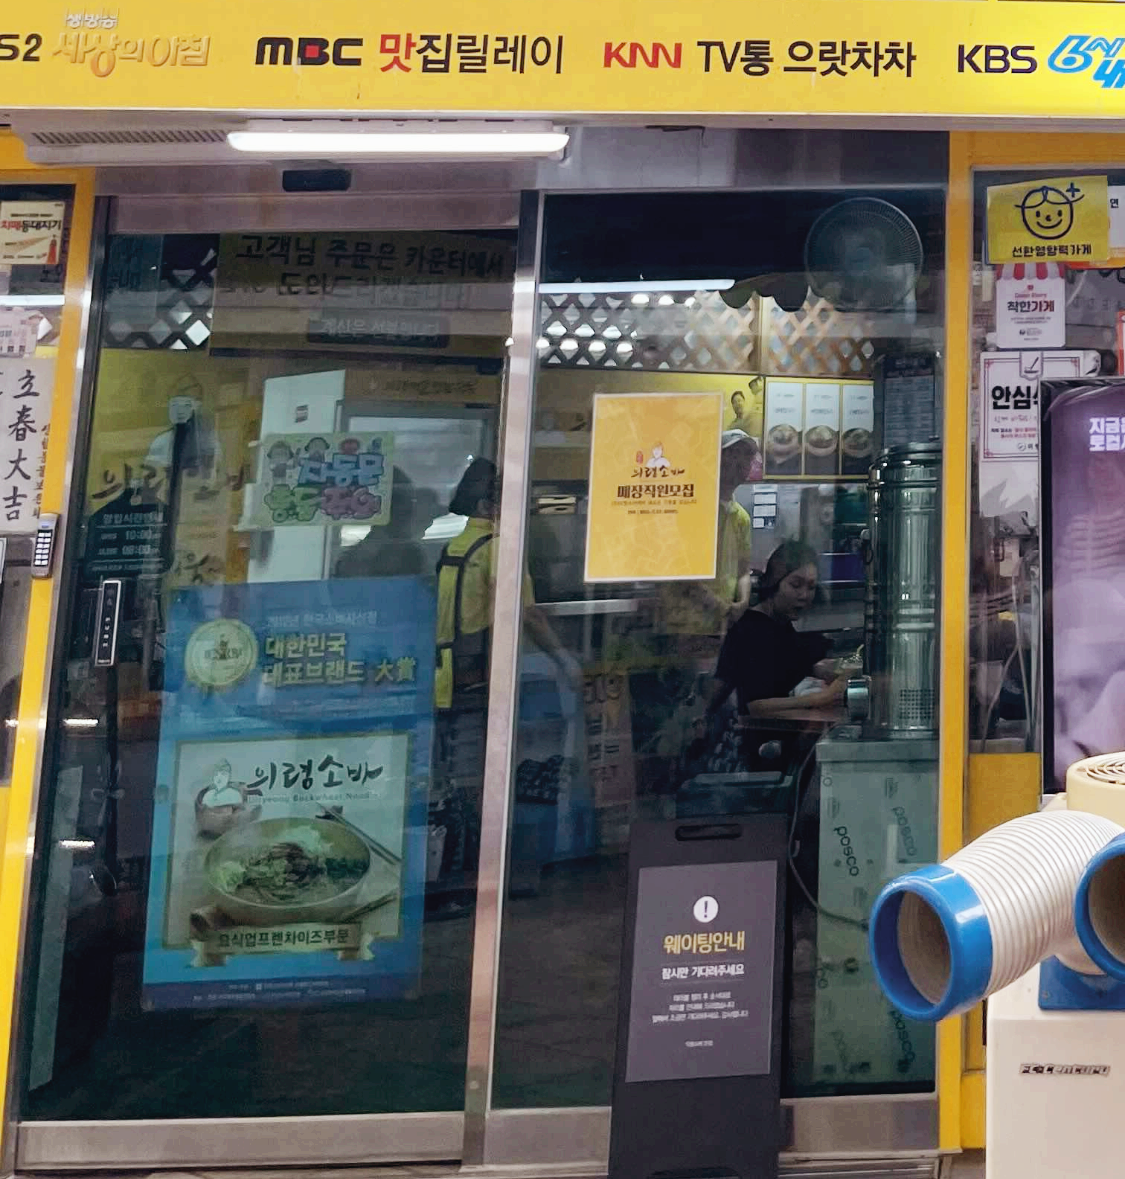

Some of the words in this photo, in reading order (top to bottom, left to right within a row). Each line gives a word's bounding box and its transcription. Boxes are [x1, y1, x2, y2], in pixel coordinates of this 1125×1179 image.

[378, 32, 565, 75] 맛집릴레이
[602, 42, 683, 69] KNN
[697, 39, 775, 76] TV통
[783, 40, 916, 78] 으랏차차
[958, 44, 1036, 74] KBS
[236, 234, 316, 267] 고객님
[1007, 299, 1055, 313] 착한가게
[991, 384, 1038, 410] 안심
[3, 369, 41, 521] 立春大吉
[265, 632, 347, 659] 대한민국
[264, 659, 366, 688] 대표브랜드
[247, 755, 384, 792] 의령소바
[834, 825, 860, 877] posco
[663, 930, 746, 955] 웨이팅안내
[661, 966, 689, 981] 잠시만
[691, 963, 745, 978] 기다려주세요
